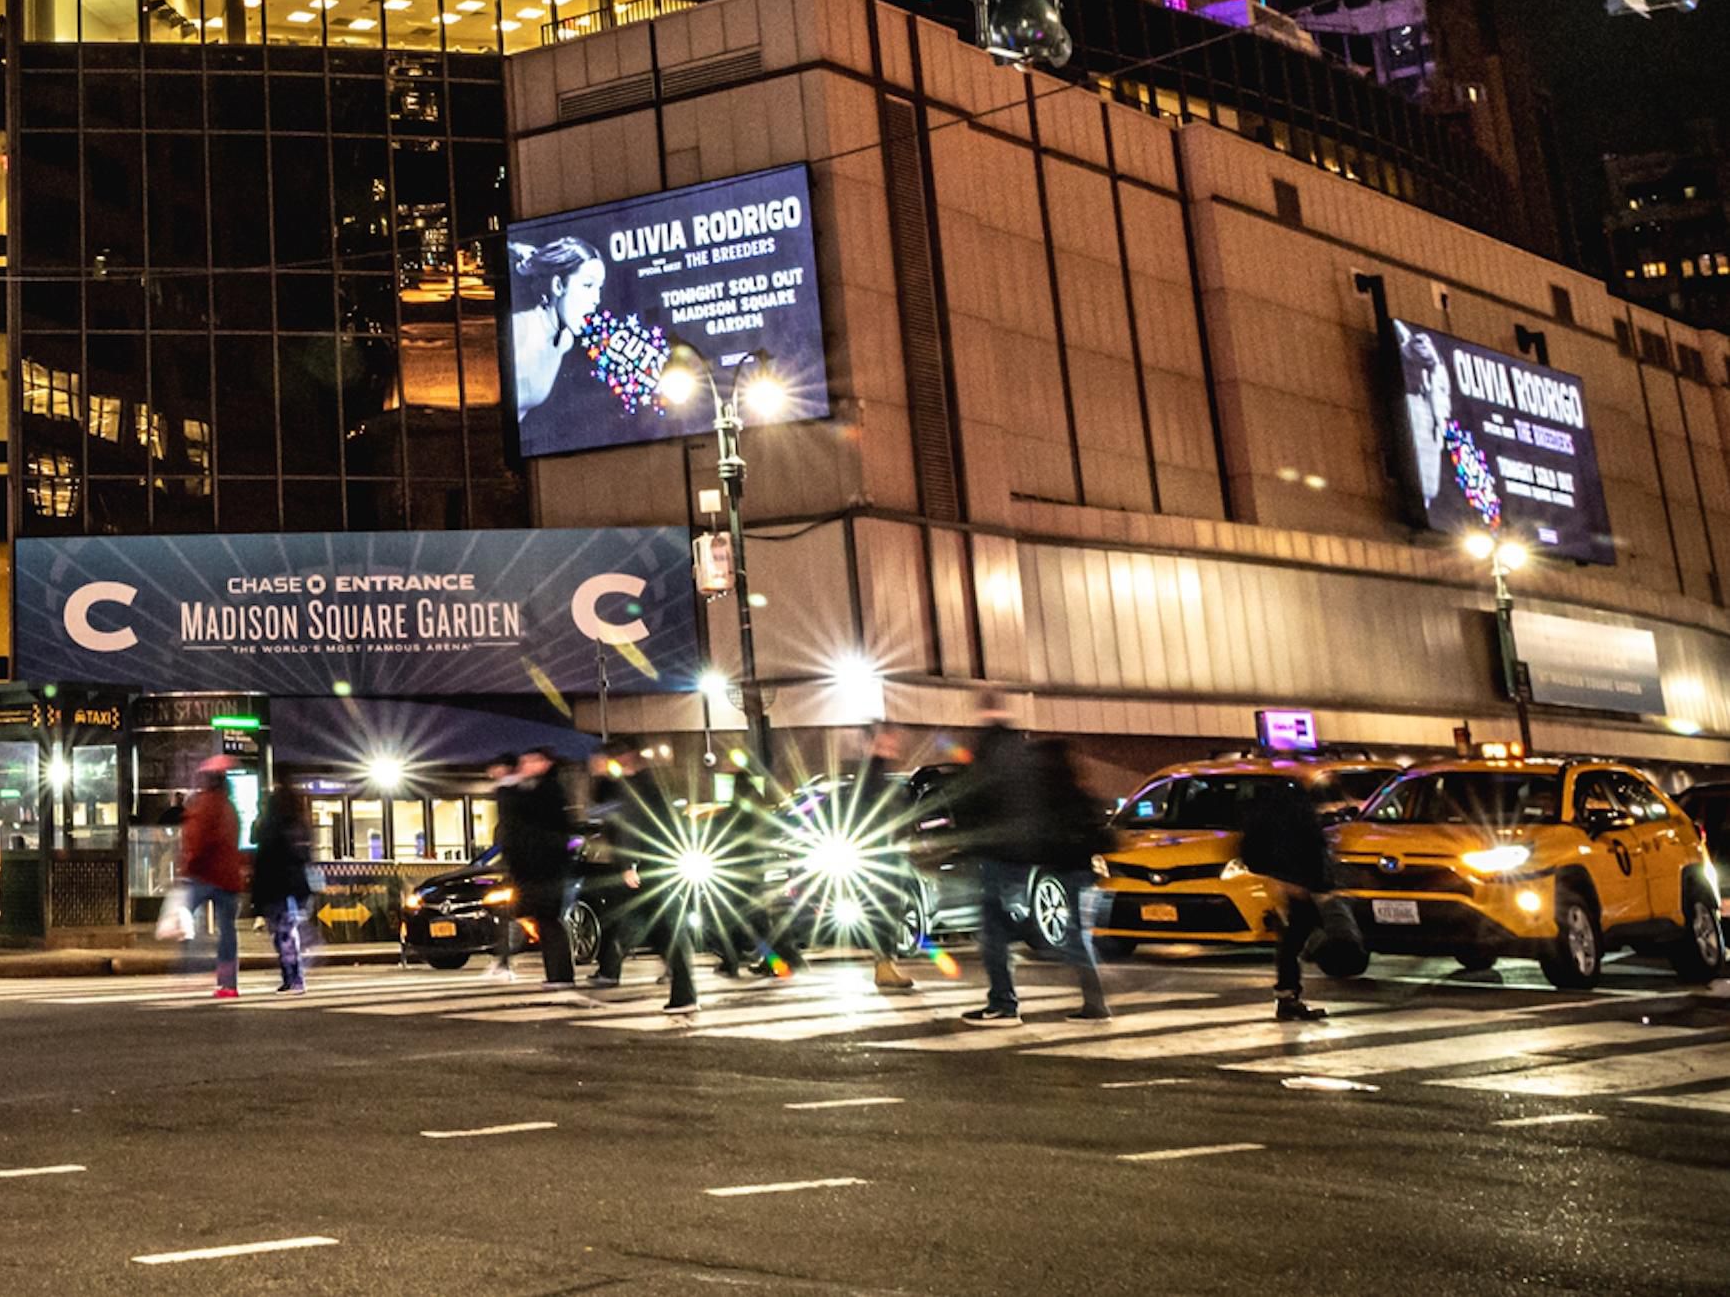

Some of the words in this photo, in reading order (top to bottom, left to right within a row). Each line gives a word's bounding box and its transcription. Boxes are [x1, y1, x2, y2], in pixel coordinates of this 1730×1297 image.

[609, 219, 687, 262] OLIVIA
[692, 196, 802, 247] RODRIGO
[684, 250, 710, 269] THE
[712, 237, 776, 264] BREEDERS
[661, 282, 725, 308] TONIGHT
[728, 274, 769, 297] SOLD
[772, 267, 805, 288] OUT
[672, 300, 738, 324] MADISON
[740, 289, 797, 312] SQUARE
[705, 313, 764, 336] GARDEN
[1453, 348, 1515, 410] OLIVIA
[1510, 365, 1585, 430] RODRIGO
[227, 577, 303, 594] CHASE
[335, 574, 476, 592] ENTRANCE
[180, 600, 298, 642] MADISON
[308, 599, 408, 642] SQUARE
[417, 598, 520, 639] GARDEN
[232, 646, 257, 654] THE
[262, 645, 320, 653] WORLD'S
[326, 644, 362, 652] MOST
[367, 643, 420, 652] FAMOUS
[85, 709, 112, 725] TAXI
